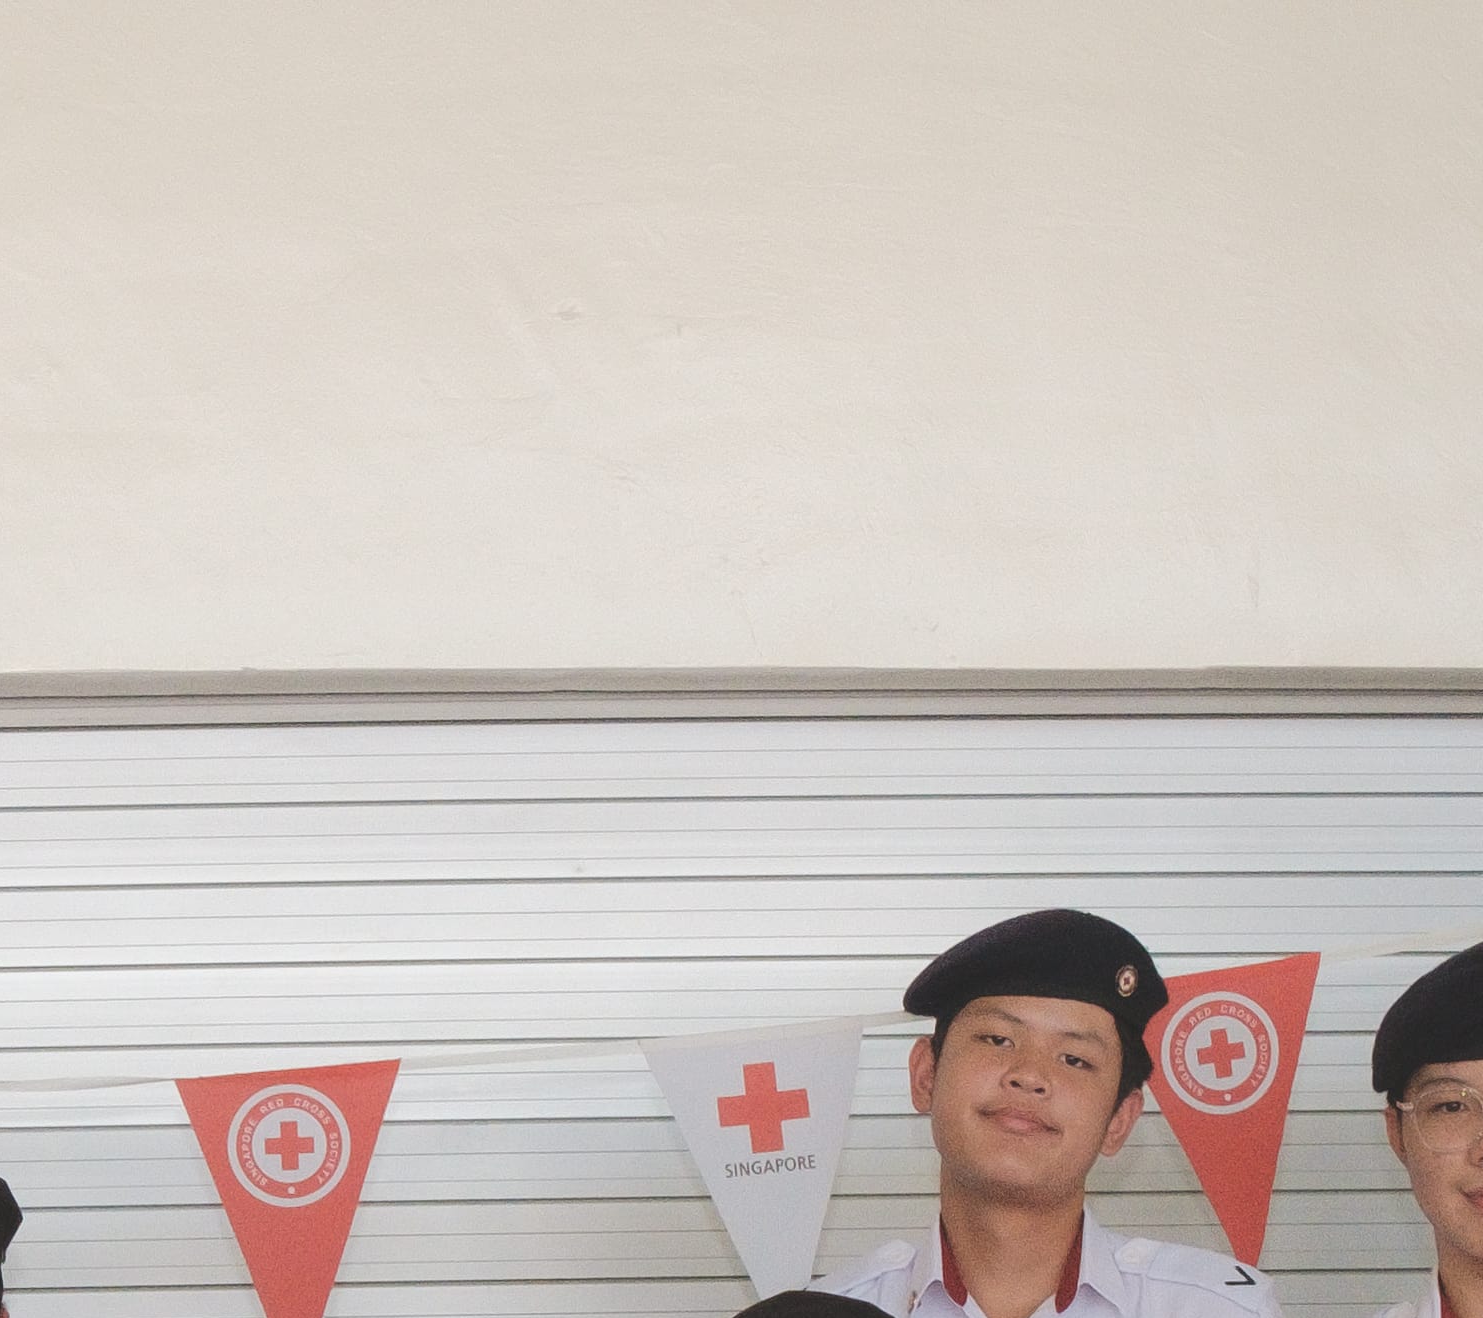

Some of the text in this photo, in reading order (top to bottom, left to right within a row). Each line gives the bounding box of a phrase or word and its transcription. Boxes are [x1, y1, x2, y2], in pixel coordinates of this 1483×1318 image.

[1189, 1007, 1212, 1026] RED
[259, 1098, 284, 1115] RED
[294, 1098, 332, 1125] CROSS
[724, 1153, 817, 1180] SINGAPORE
